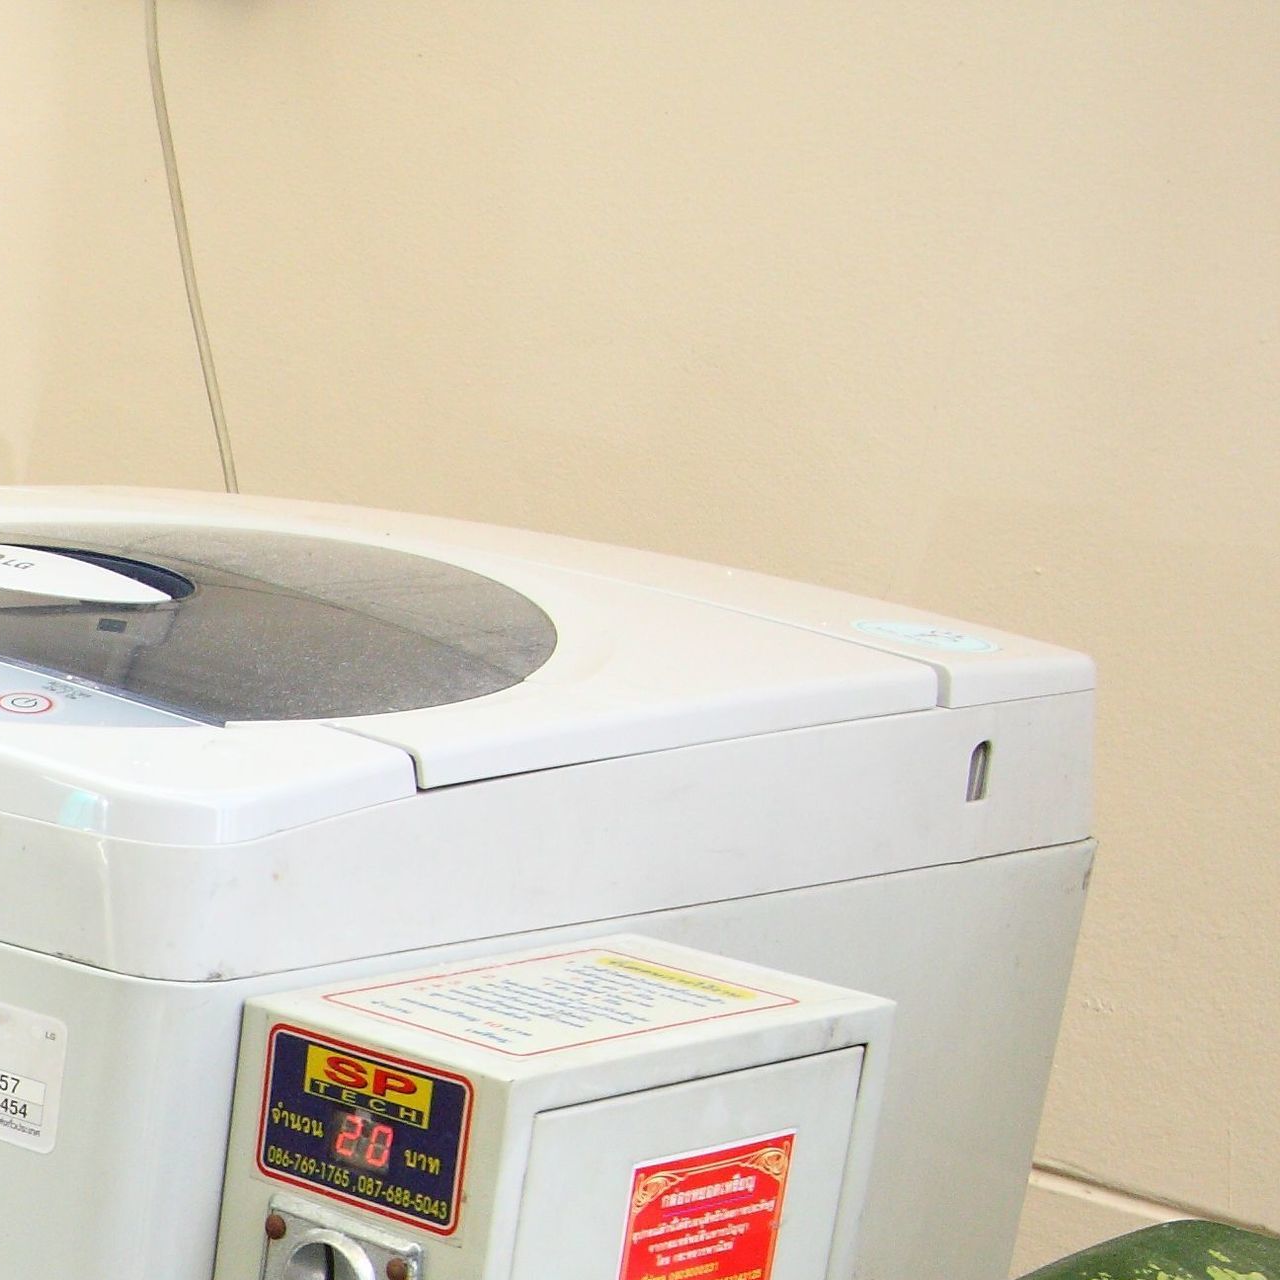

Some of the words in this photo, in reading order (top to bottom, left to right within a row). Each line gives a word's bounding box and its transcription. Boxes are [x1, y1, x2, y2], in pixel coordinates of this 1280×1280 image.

[1, 559, 35, 570] LG
[323, 1055, 418, 1097] SP
[314, 1080, 418, 1122] TECH
[271, 1102, 324, 1139] จำนวน
[335, 1113, 394, 1168] 20
[404, 1149, 441, 1176] บาท
